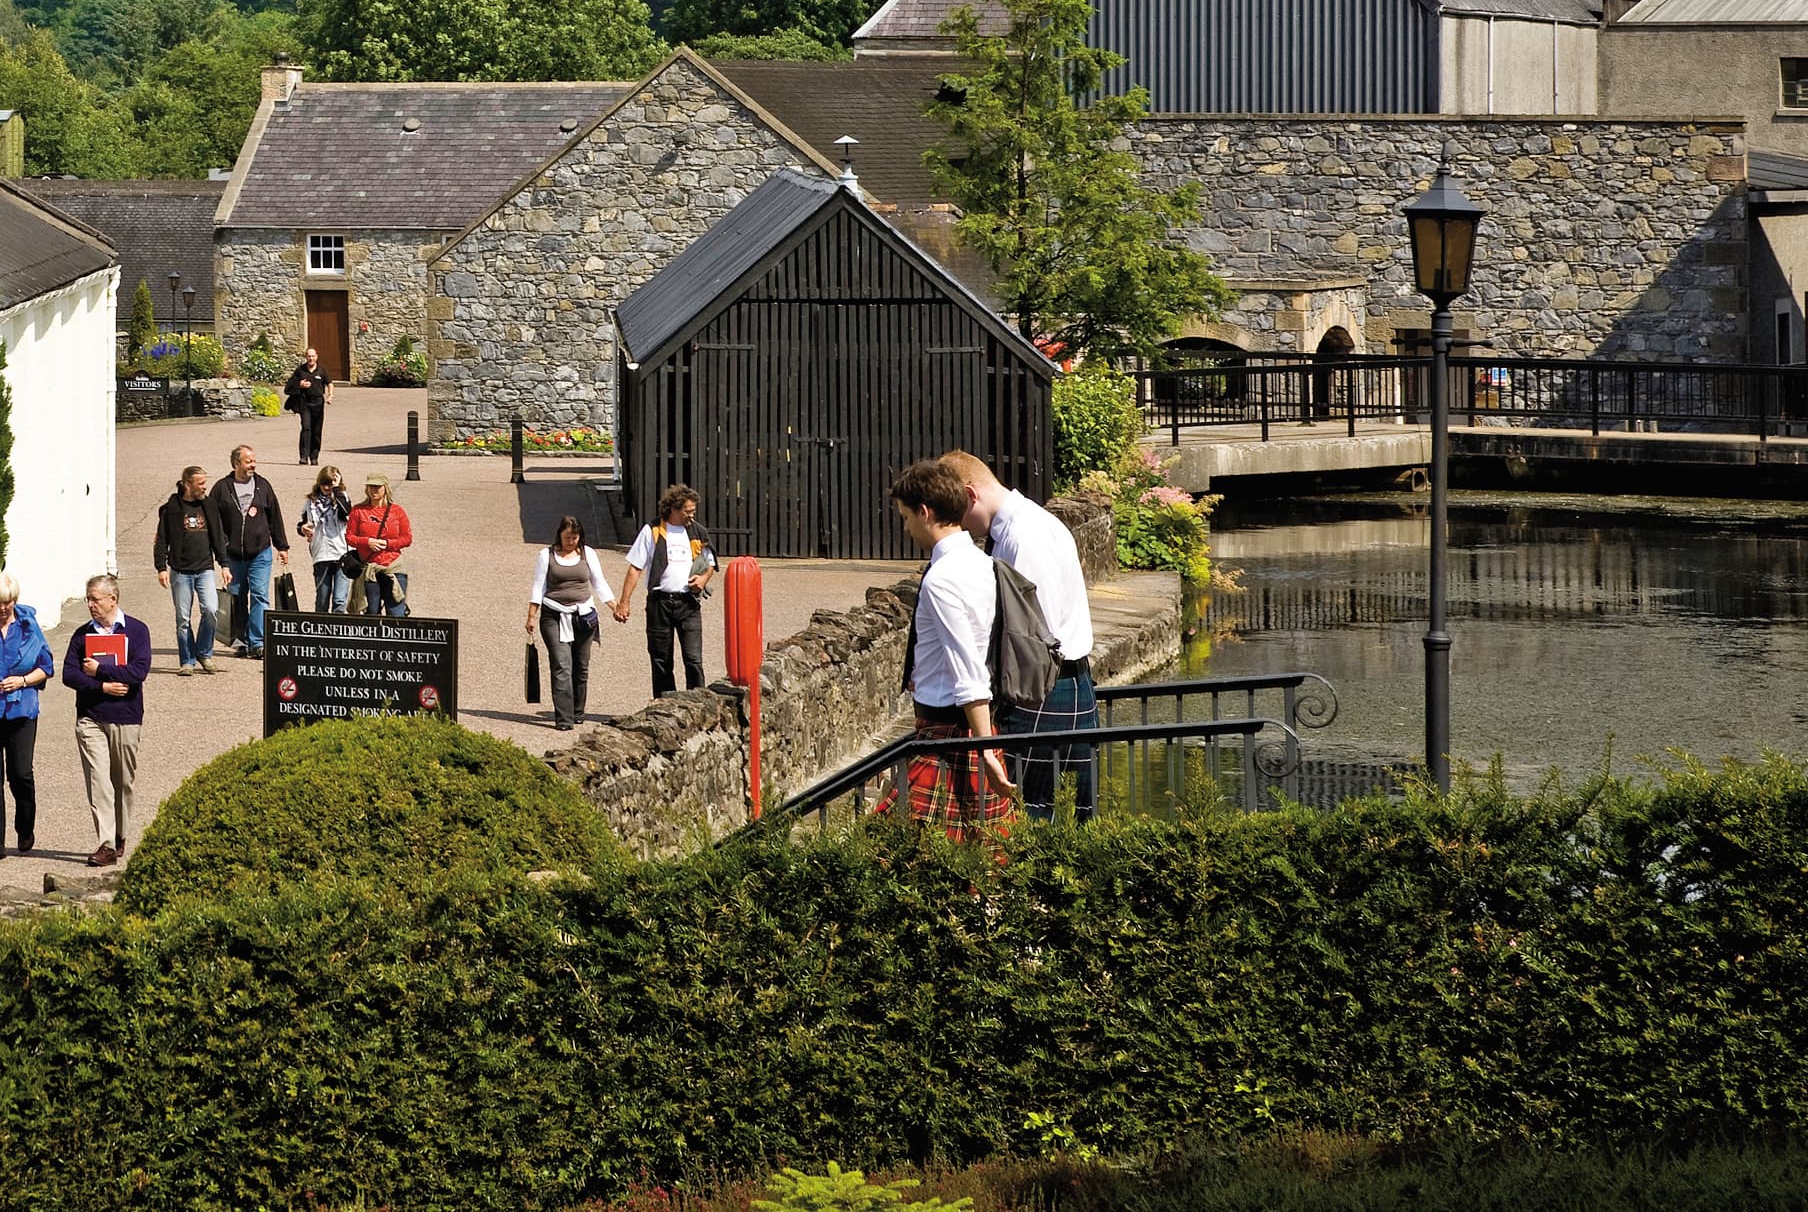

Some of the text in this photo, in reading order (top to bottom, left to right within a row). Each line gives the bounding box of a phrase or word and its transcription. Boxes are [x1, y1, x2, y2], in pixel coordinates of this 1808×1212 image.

[124, 380, 162, 388] VISITORS
[272, 619, 448, 641] THE GLENFIDDICH DISTILLERY
[276, 644, 440, 664] IN THE INTEREST OF SAFETY
[297, 664, 424, 683] PLEASE DO NOT SMOKE
[325, 686, 400, 701] UNLESS IN A
[279, 702, 347, 717] DESIGNATED
[350, 706, 402, 718] SMOKNG
